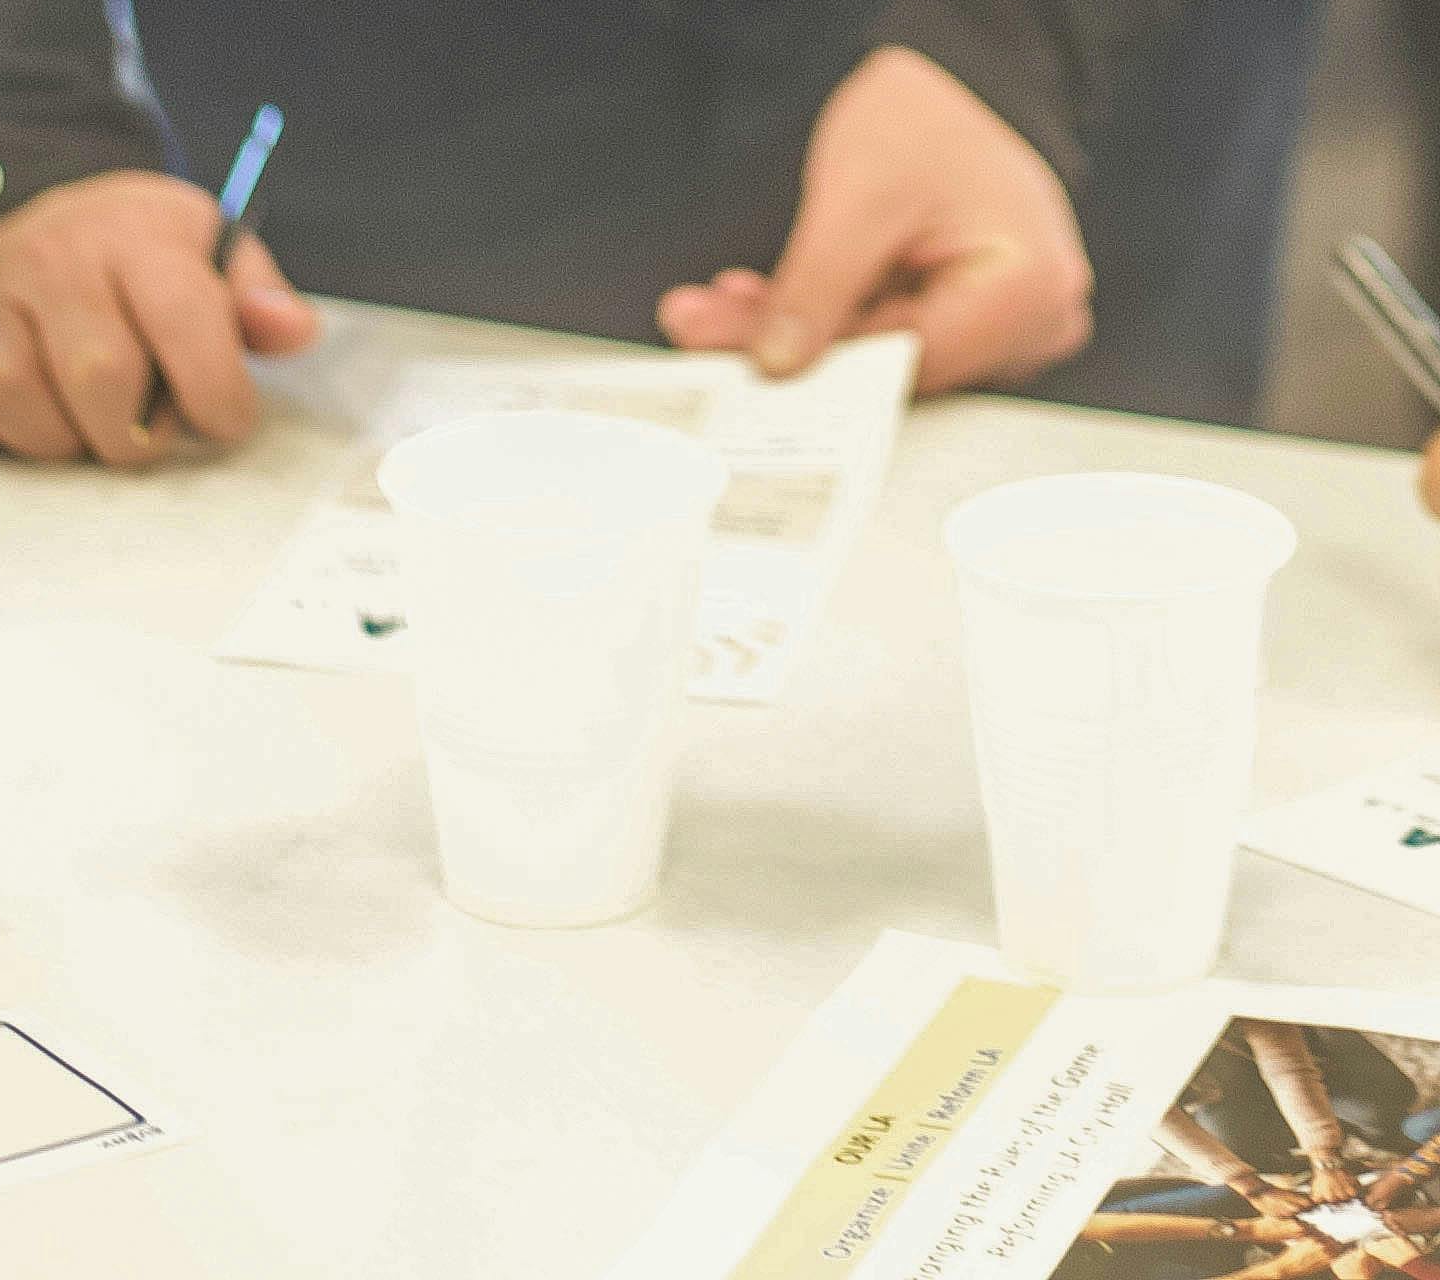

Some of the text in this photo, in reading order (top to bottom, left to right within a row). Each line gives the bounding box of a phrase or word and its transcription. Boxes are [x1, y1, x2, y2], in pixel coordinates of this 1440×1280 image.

[821, 1186, 894, 1259] Organize
[925, 1068, 988, 1121] Reform
[969, 1046, 1004, 1066] LA
[832, 1112, 897, 1165] OUR LA
